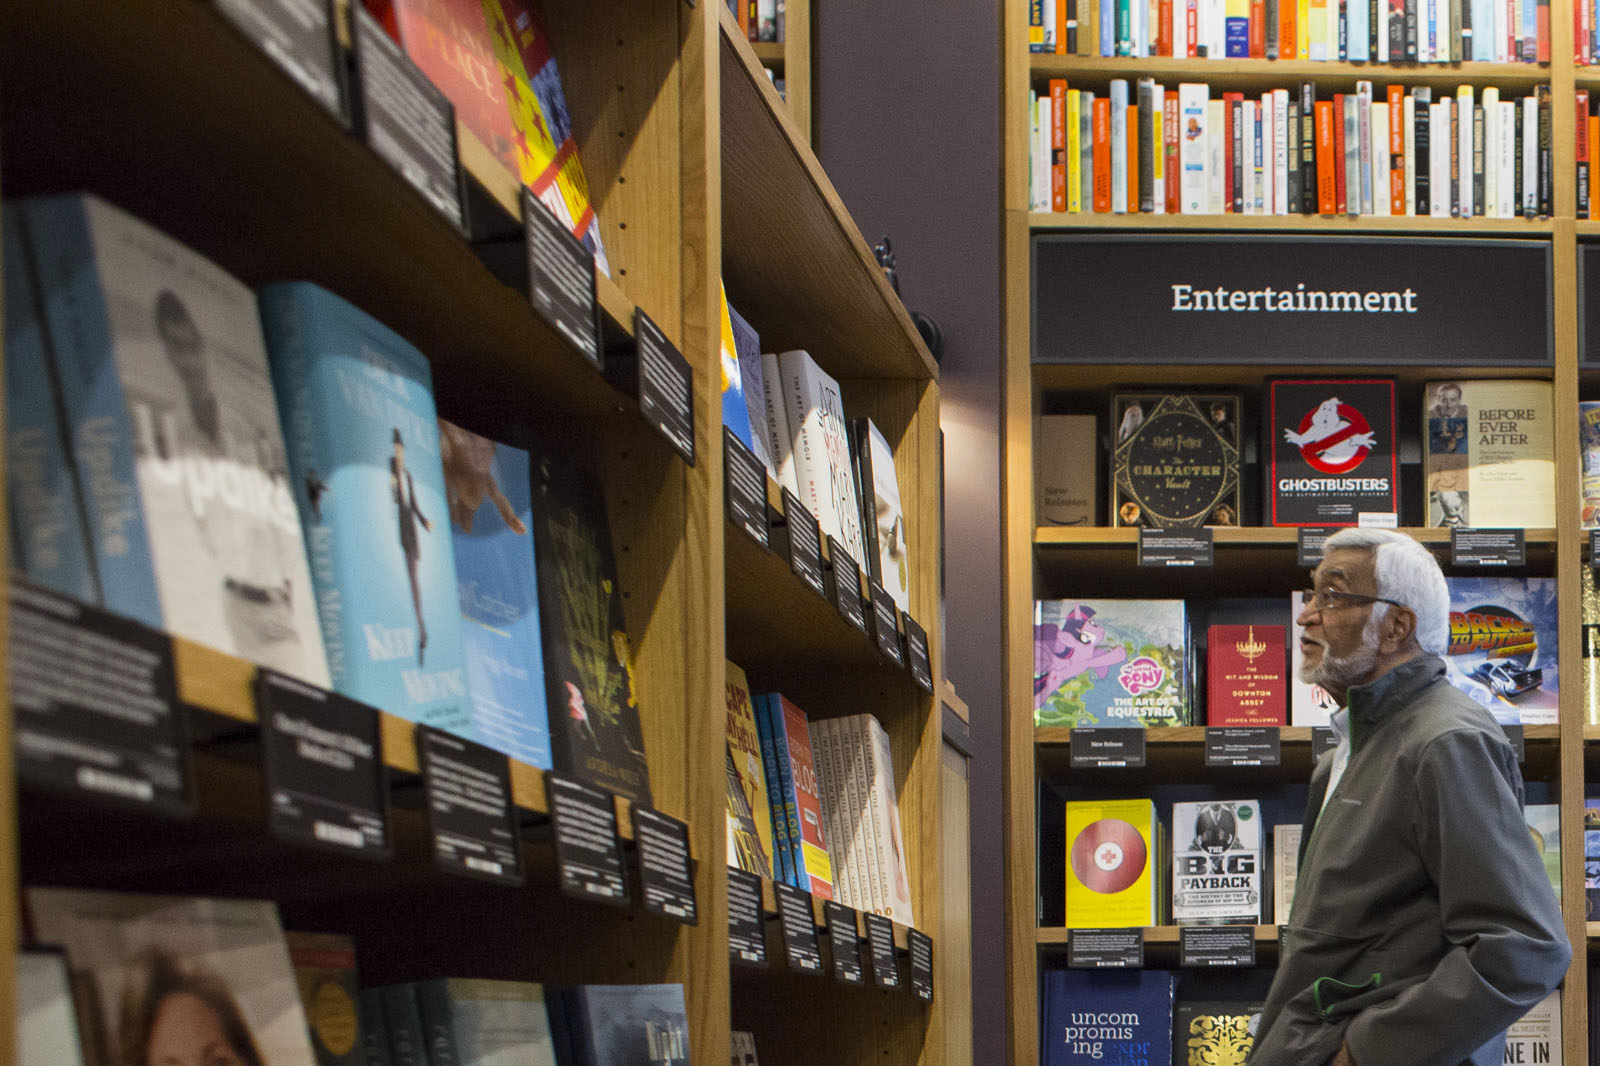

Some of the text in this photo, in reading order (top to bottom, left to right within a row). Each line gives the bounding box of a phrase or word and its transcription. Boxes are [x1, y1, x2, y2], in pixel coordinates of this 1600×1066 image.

[1172, 284, 1418, 313] Entertainment
[1479, 409, 1536, 421] BEFORE
[1479, 422, 1518, 433] EVER
[802, 428, 811, 462] MEMOIR
[1479, 434, 1528, 446] AFTER
[773, 431, 783, 466] MEMOIR
[1133, 465, 1221, 476] CHARACTER
[1165, 477, 1191, 489] Vault
[1279, 478, 1389, 493] GHOSTBUSTERS
[1119, 666, 1165, 694] PONY
[1113, 698, 1131, 706] THE
[1132, 698, 1152, 706] ART
[1107, 708, 1176, 718] EQUESTRIA
[772, 803, 788, 841] BLOG
[785, 801, 800, 839] BLOG
[1208, 846, 1223, 854] THE
[1176, 854, 1255, 875] BIG
[1180, 877, 1250, 889] PAYBACK
[1071, 1012, 1140, 1026] uncom
[1065, 1027, 1133, 1043] promis
[1072, 1042, 1103, 1059] ing
[1533, 1042, 1551, 1064] IN
